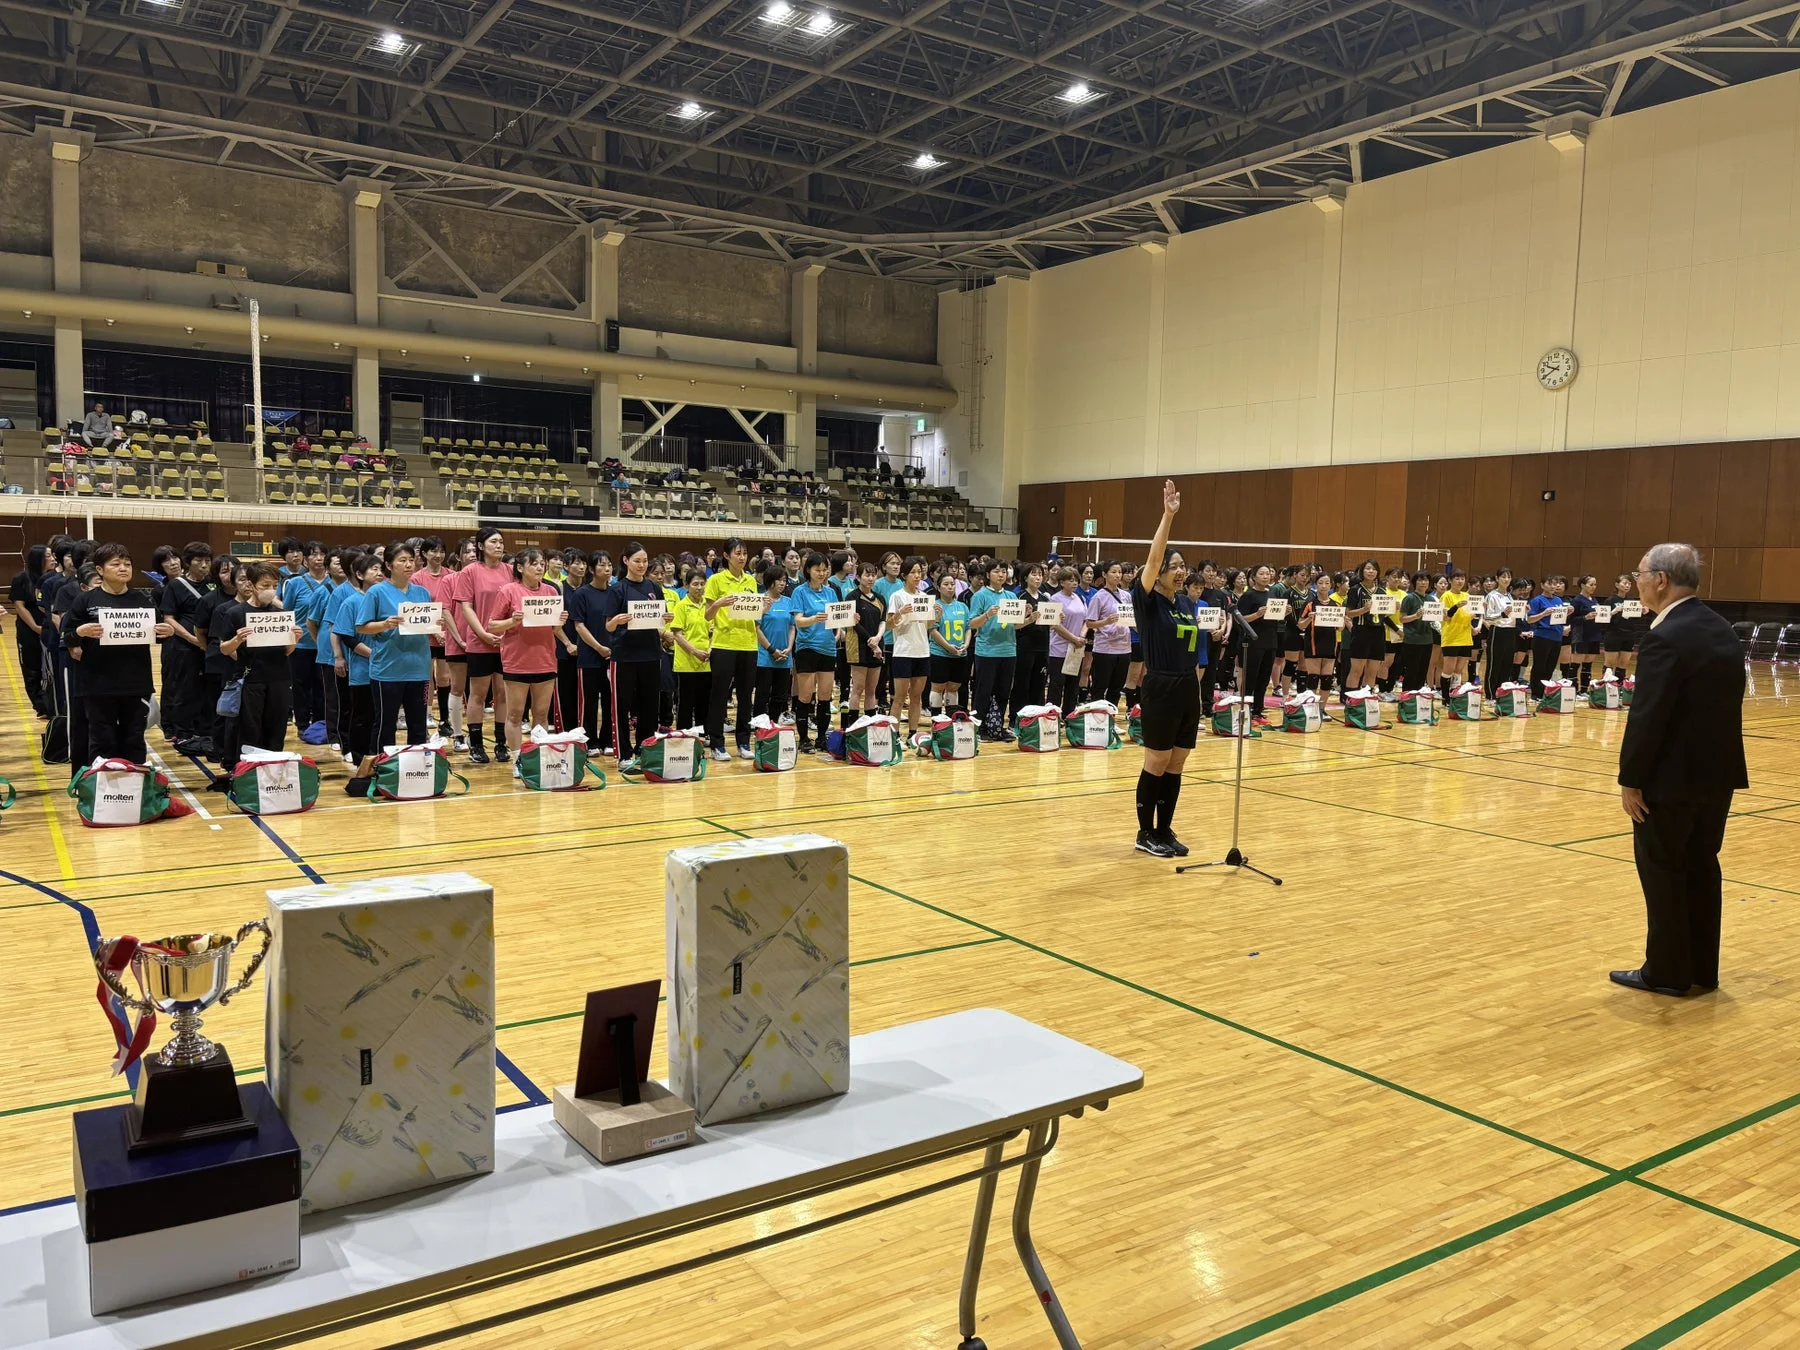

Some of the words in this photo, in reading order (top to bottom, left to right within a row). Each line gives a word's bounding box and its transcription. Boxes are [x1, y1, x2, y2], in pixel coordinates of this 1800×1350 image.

[524, 598, 562, 607] 浅間台クラブ
[534, 607, 552, 615] (上尾)
[732, 604, 760, 612] (さいたま)
[250, 615, 293, 624] エンジェルス
[409, 616, 431, 624] (上尾)
[254, 625, 290, 633] (さいたま)
[944, 620, 964, 640] 15
[109, 631, 147, 639] (さいたま)
[1176, 624, 1199, 652] 7
